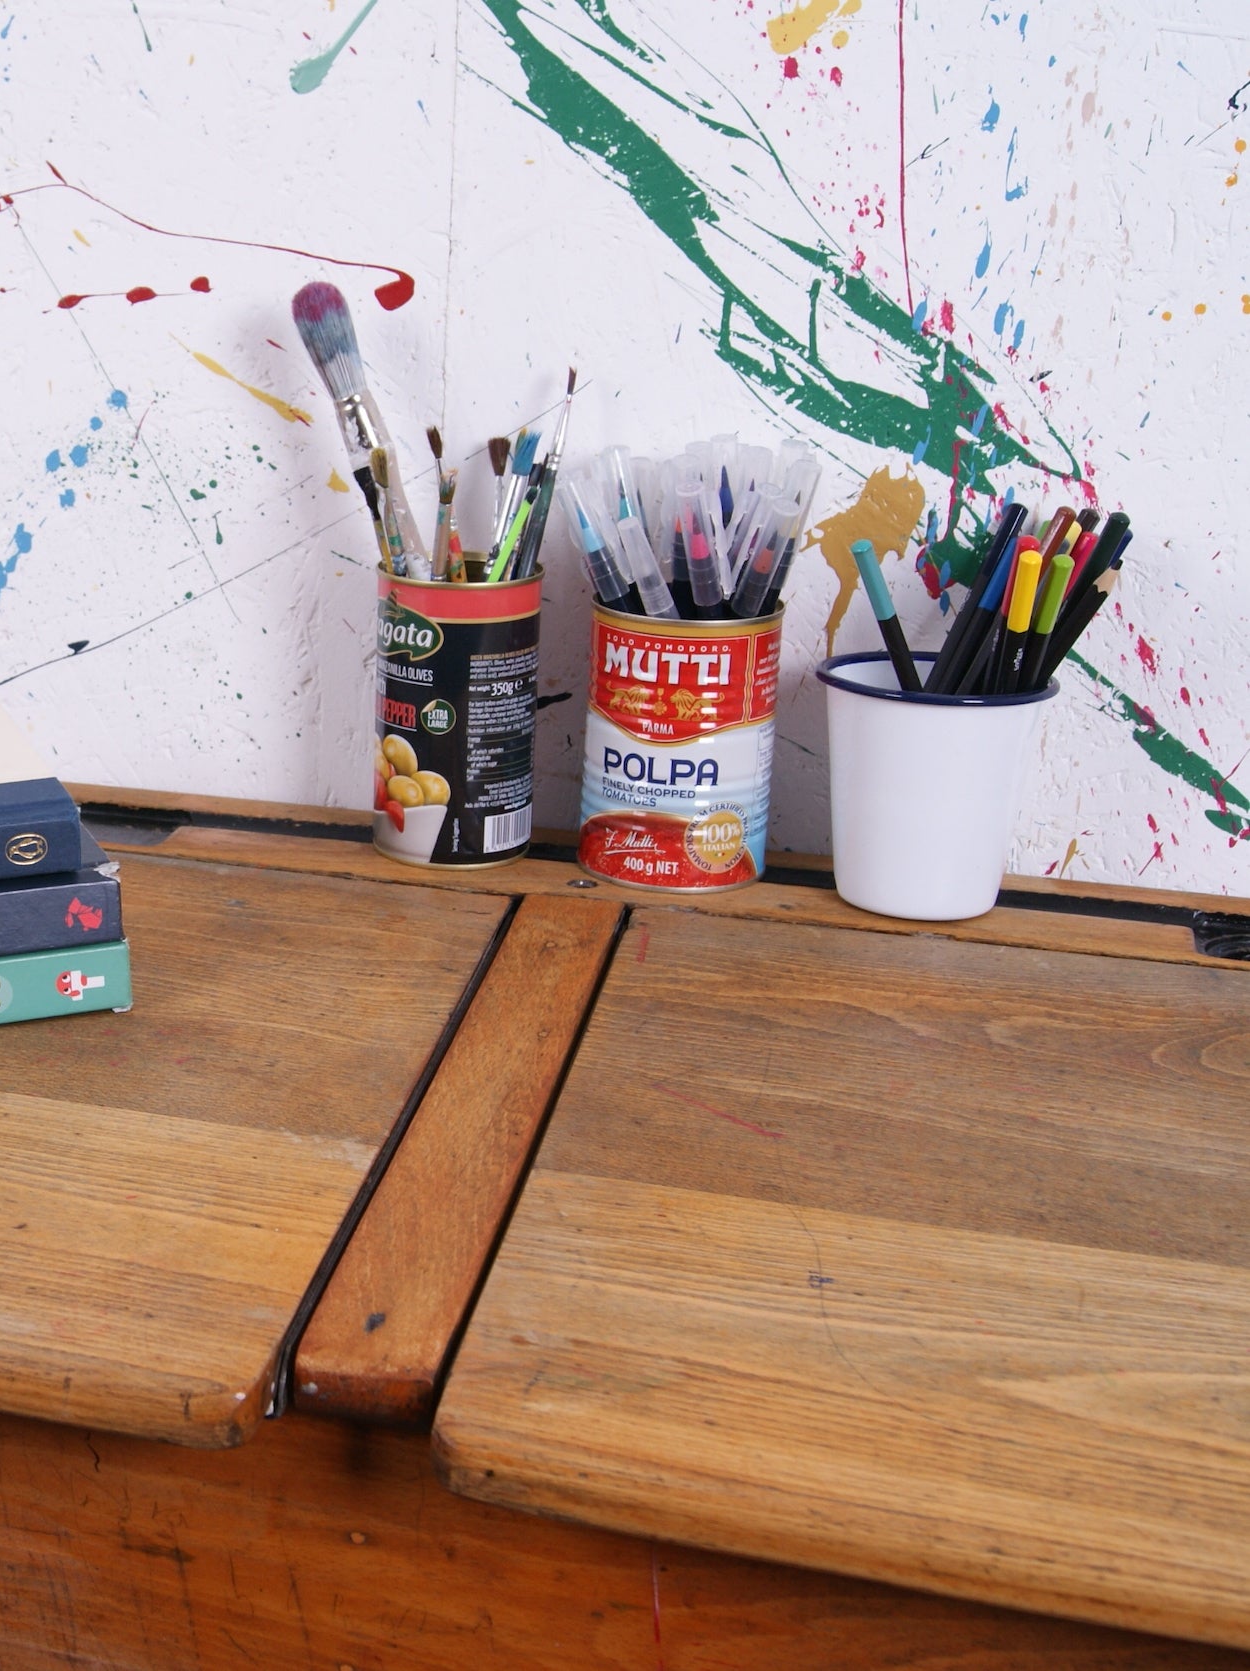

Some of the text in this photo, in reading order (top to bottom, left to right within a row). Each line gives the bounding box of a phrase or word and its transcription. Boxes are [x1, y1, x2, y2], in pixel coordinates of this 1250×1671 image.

[606, 633, 635, 646] SOLO
[604, 642, 731, 686] MUTTI
[408, 666, 434, 682] OLIVES
[490, 682, 514, 696] 350g
[428, 709, 448, 720] EXTRA
[427, 720, 448, 729] LARGE
[642, 720, 674, 736] PARMA
[604, 746, 719, 786] POLPA
[602, 776, 696, 799] FINELY CHOPPED
[602, 787, 657, 808] TOMATOES
[702, 822, 741, 844] 100%
[703, 842, 736, 852] ITALIAN
[623, 856, 679, 875] 400 g NET
